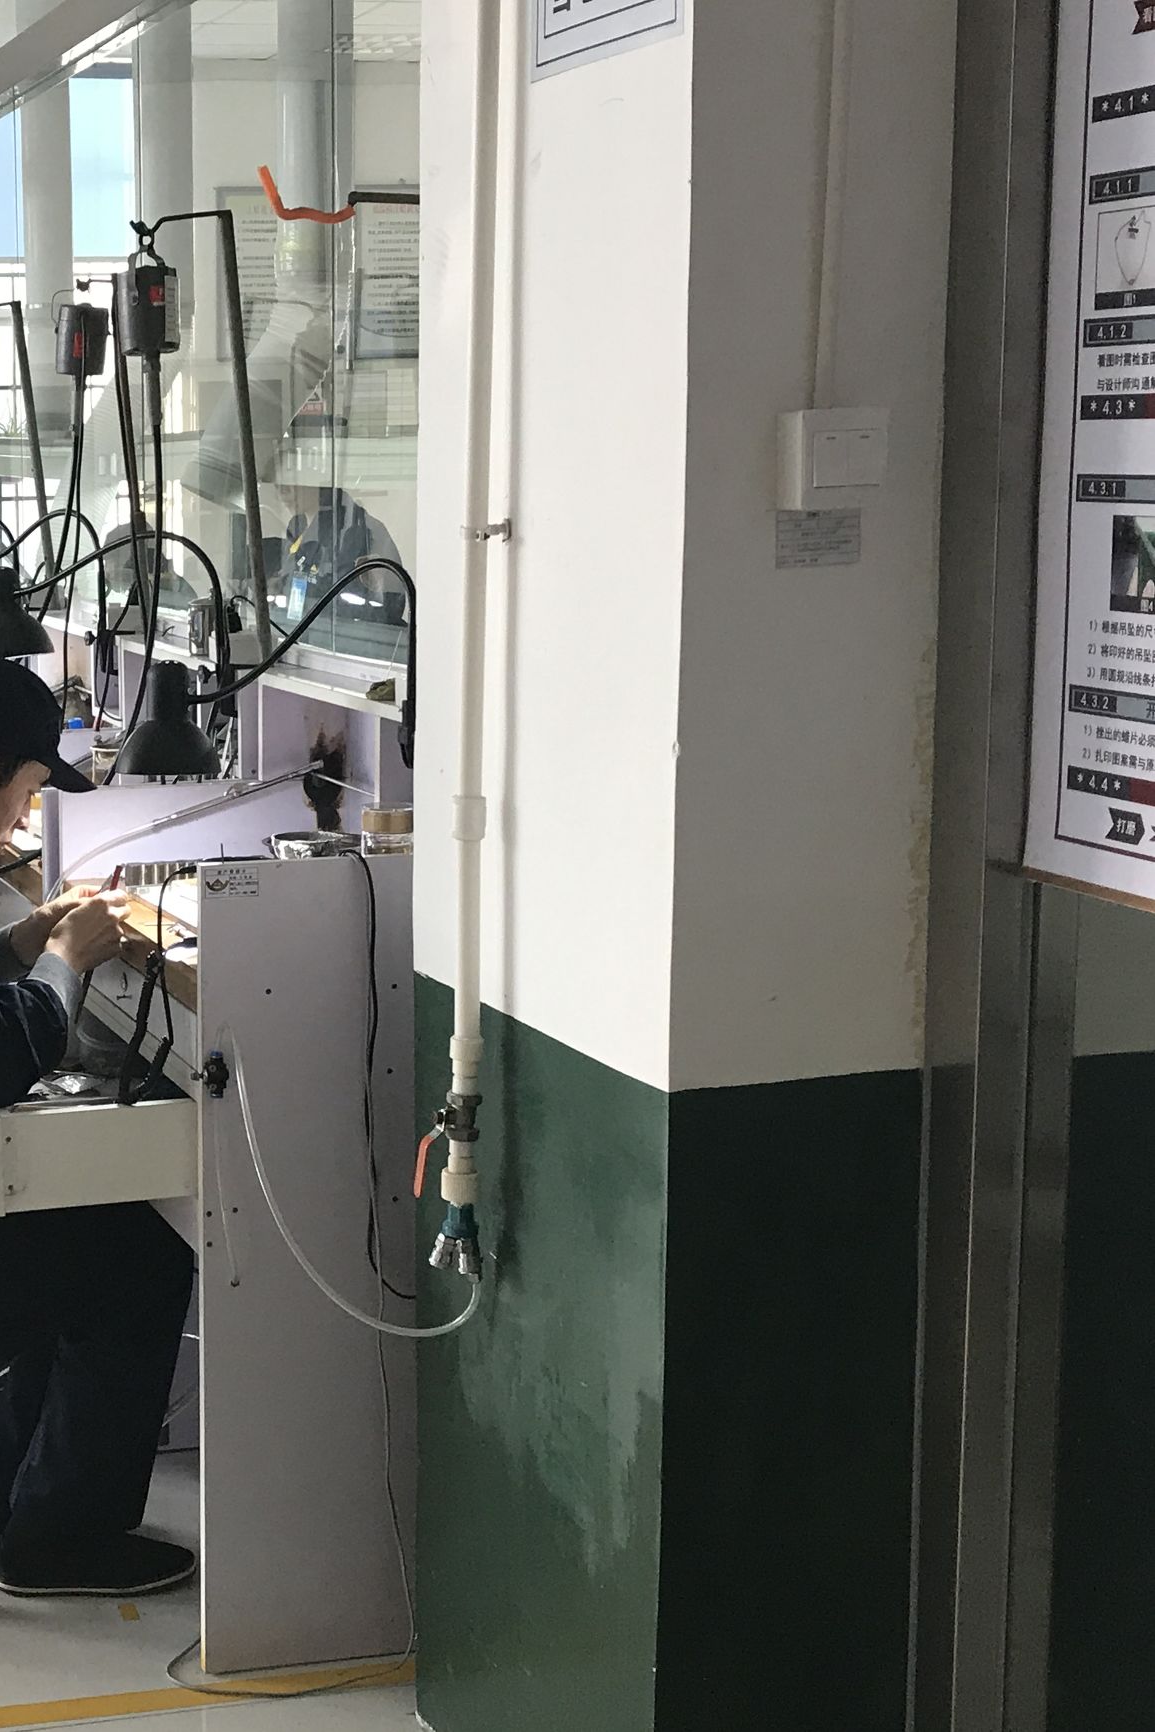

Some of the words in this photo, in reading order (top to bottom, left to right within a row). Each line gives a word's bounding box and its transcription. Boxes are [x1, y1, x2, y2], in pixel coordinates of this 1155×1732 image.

[1097, 324, 1127, 339] 4.1.2
[1088, 481, 1117, 496] 4.3.1
[1101, 621, 1155, 638] 根据吊坠的尺
[1080, 693, 1109, 710] 4.3.2
